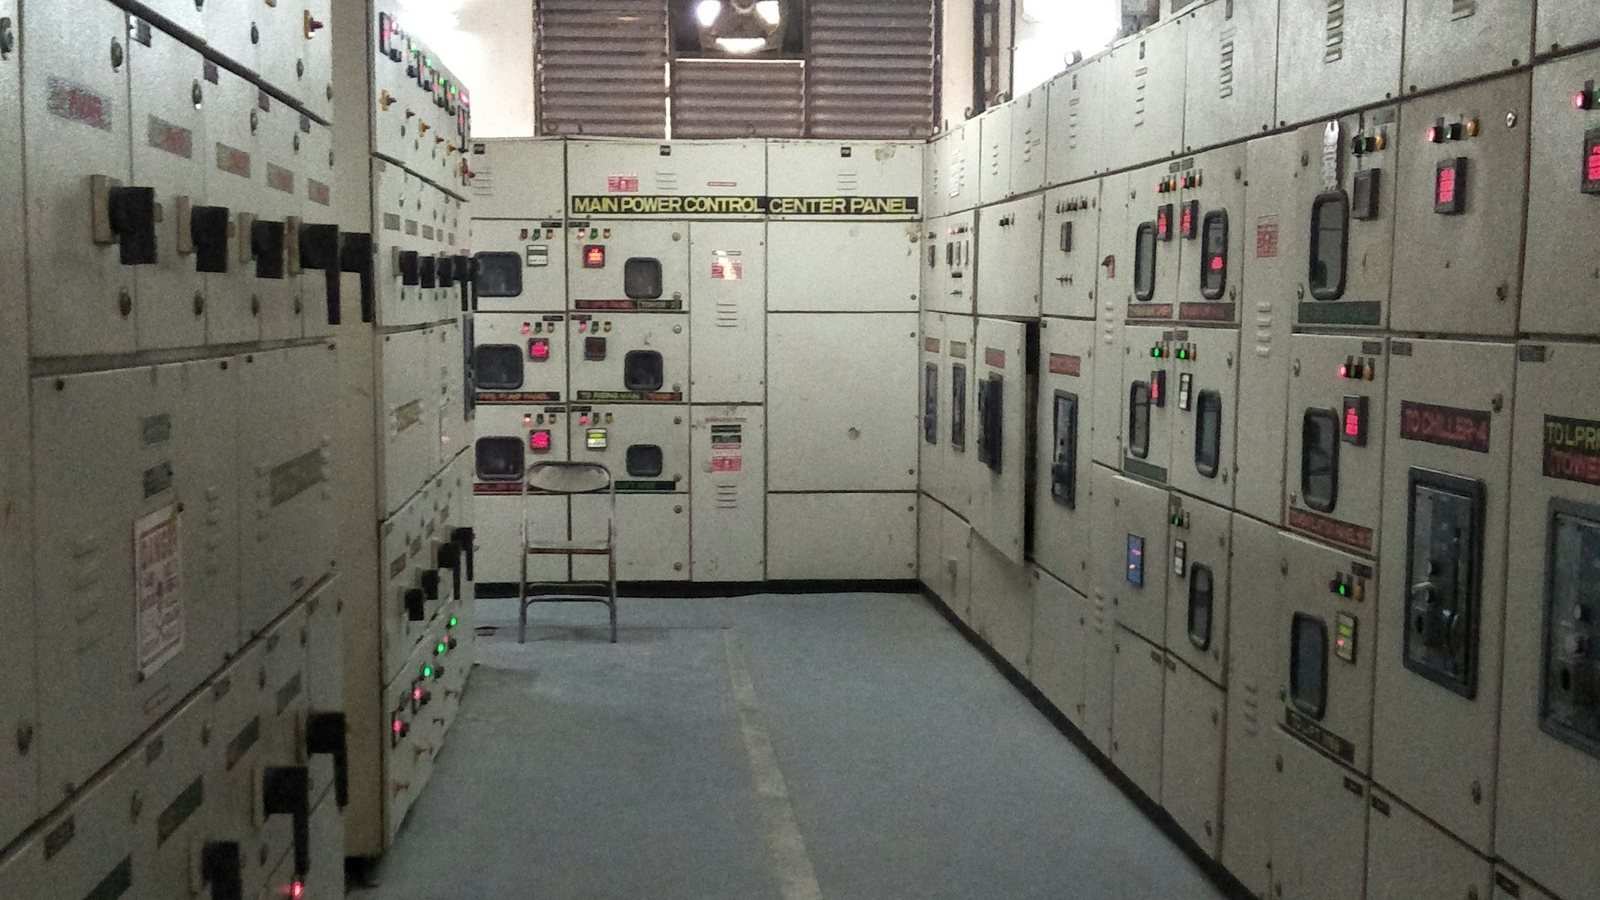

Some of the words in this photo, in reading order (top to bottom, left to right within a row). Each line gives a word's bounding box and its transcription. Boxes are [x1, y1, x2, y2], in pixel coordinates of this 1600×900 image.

[574, 197, 618, 212] MAIN
[621, 197, 682, 212] POWER
[684, 197, 765, 213] CONTROL
[768, 198, 846, 213] CENTER
[851, 198, 916, 213] PANEL
